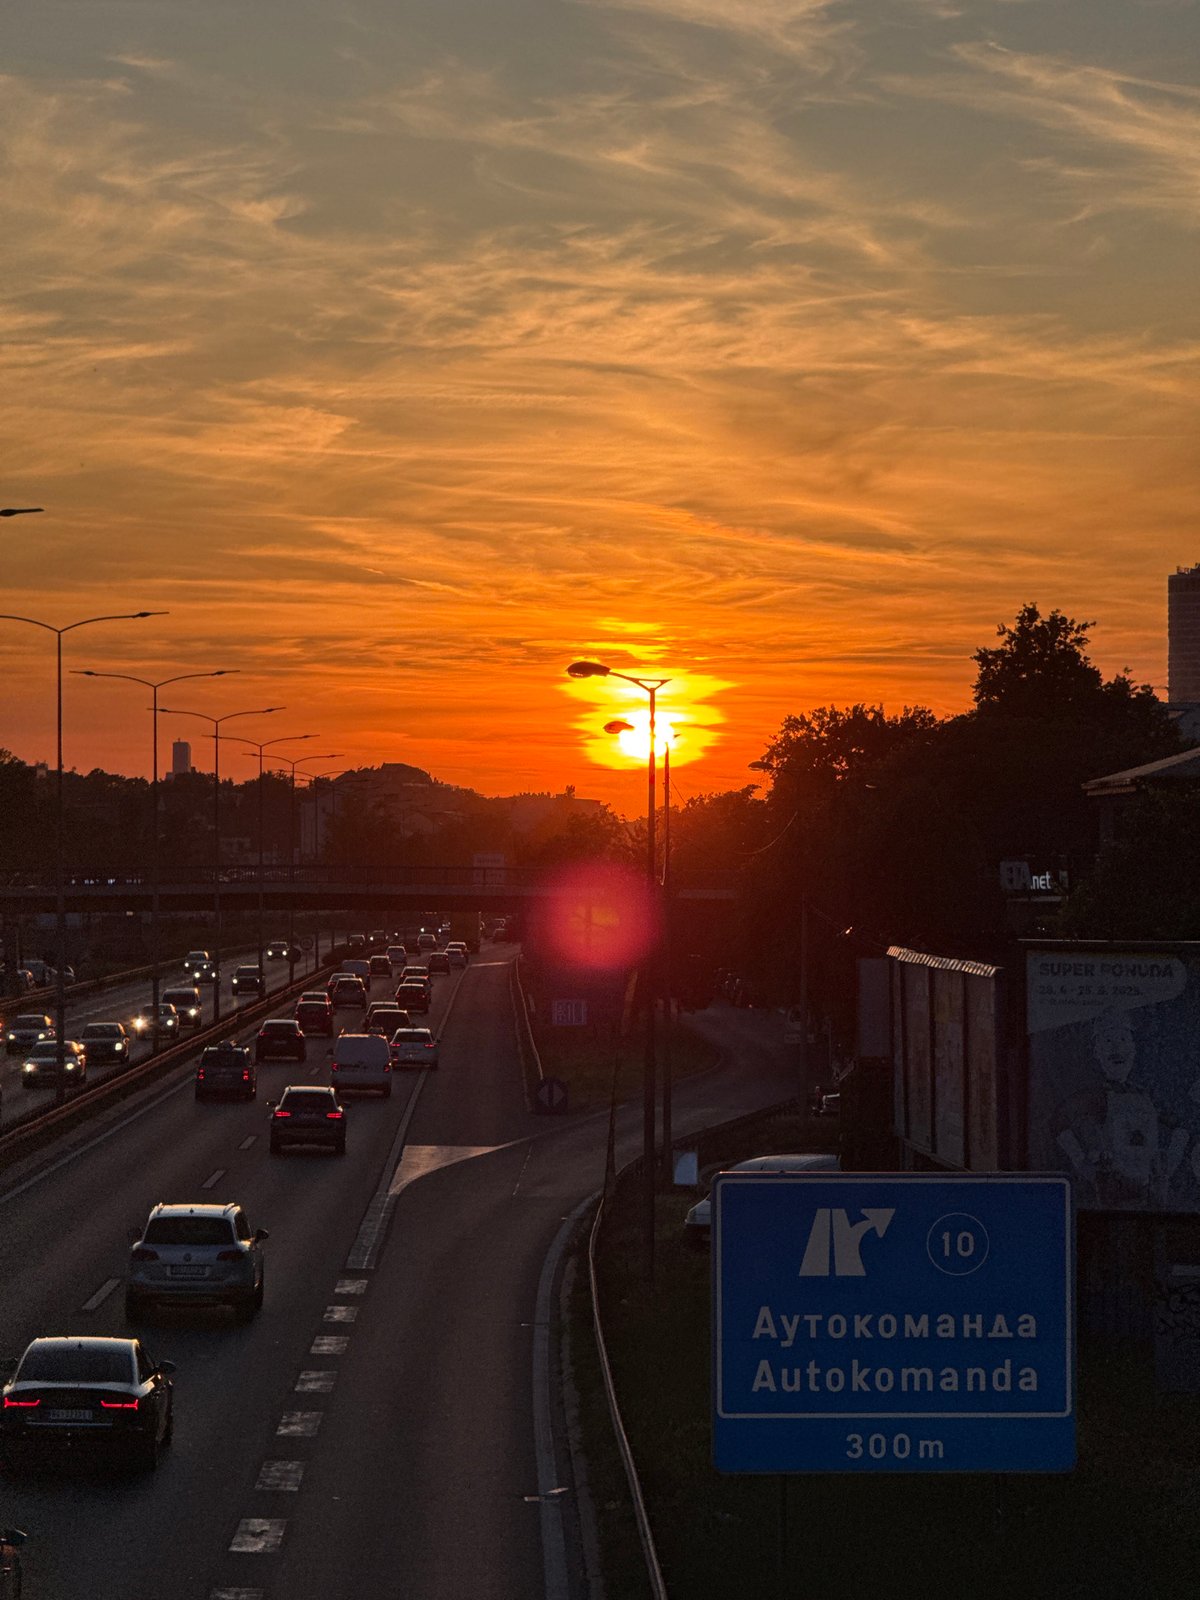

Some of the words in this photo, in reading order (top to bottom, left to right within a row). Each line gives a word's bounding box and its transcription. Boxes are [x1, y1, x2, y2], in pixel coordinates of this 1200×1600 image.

[1039, 962, 1095, 977] SUPER
[1100, 963, 1174, 978] PONUDA
[942, 1231, 975, 1257] 10
[752, 1305, 1037, 1348] Аутокоманда
[751, 1359, 1038, 1392] Autokomanda
